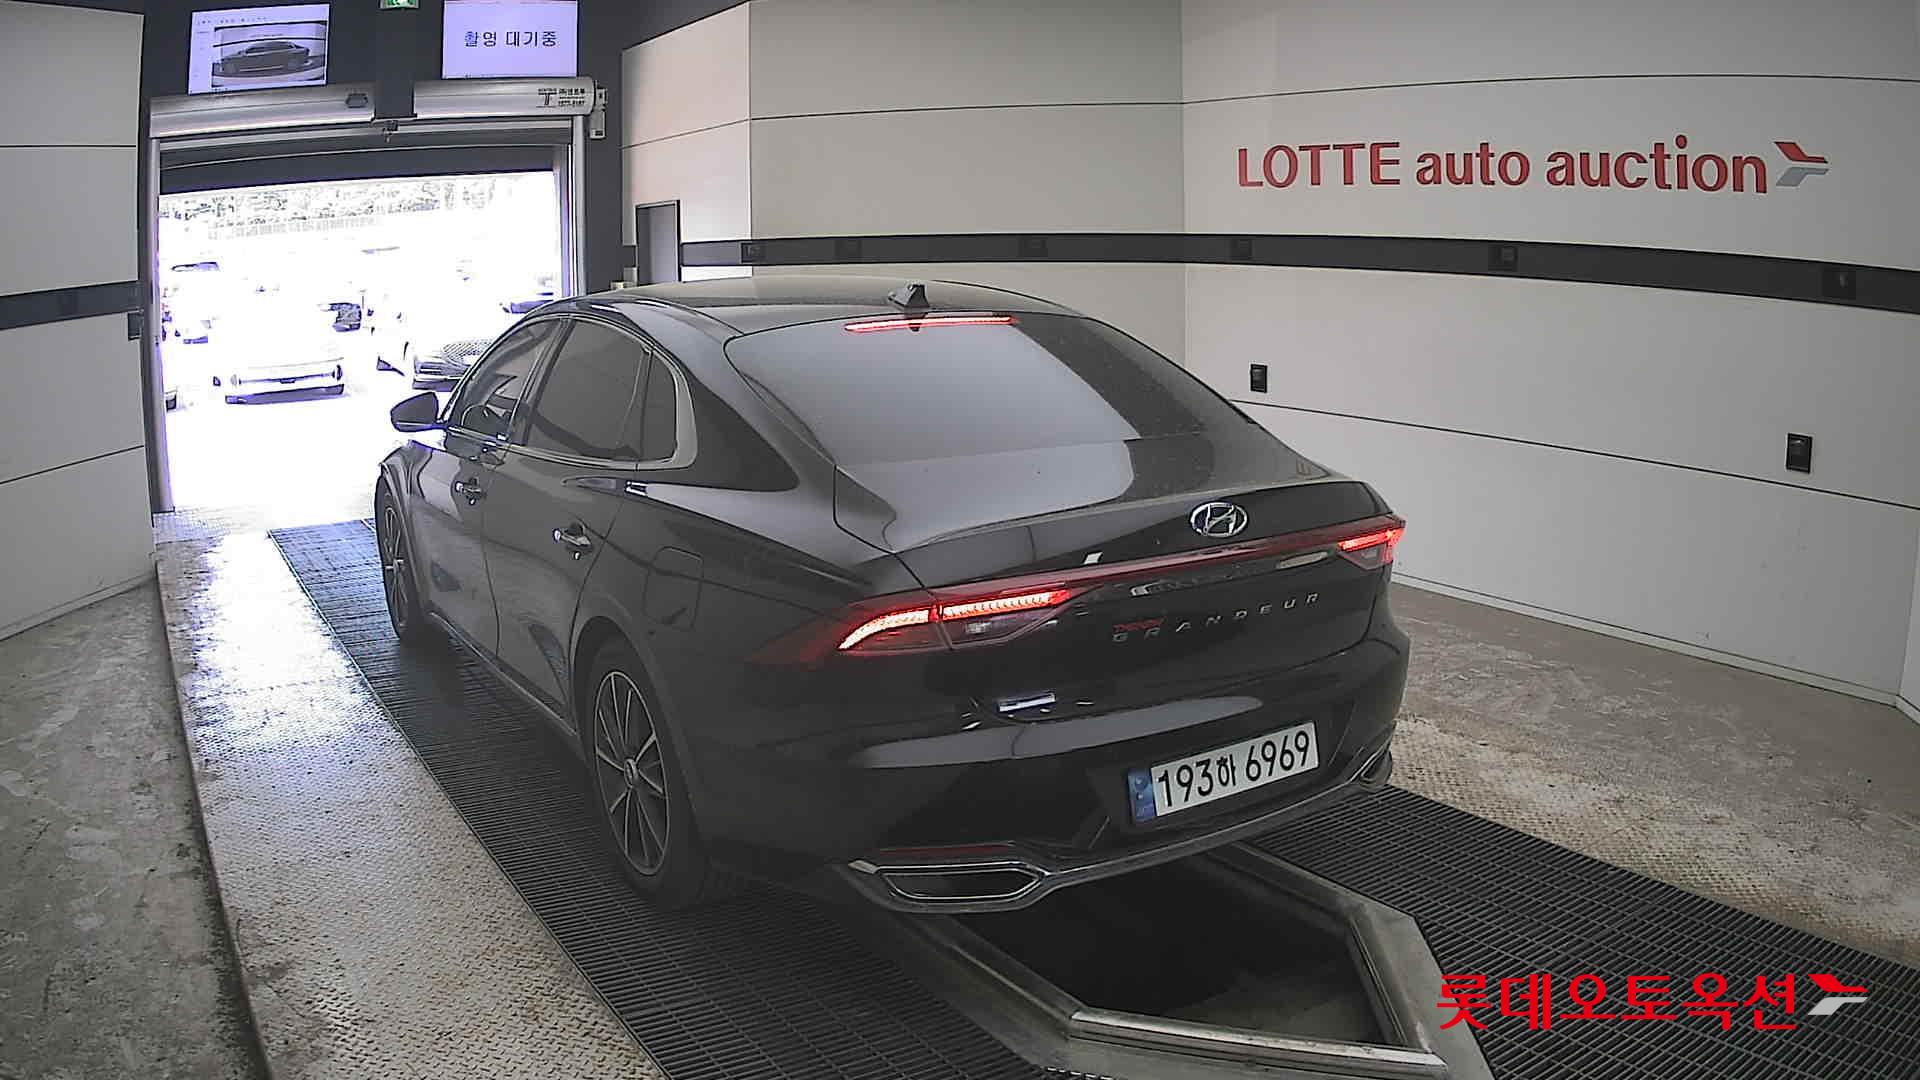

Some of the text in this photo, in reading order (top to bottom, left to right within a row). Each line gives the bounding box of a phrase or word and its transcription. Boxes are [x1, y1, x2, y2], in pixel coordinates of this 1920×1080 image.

[464, 31, 557, 48] 촬영 대기중
[1238, 134, 1767, 193] LOTTE auto auction
[1111, 592, 1318, 642] GRANDEUR
[1158, 730, 1310, 807] 193하 6969
